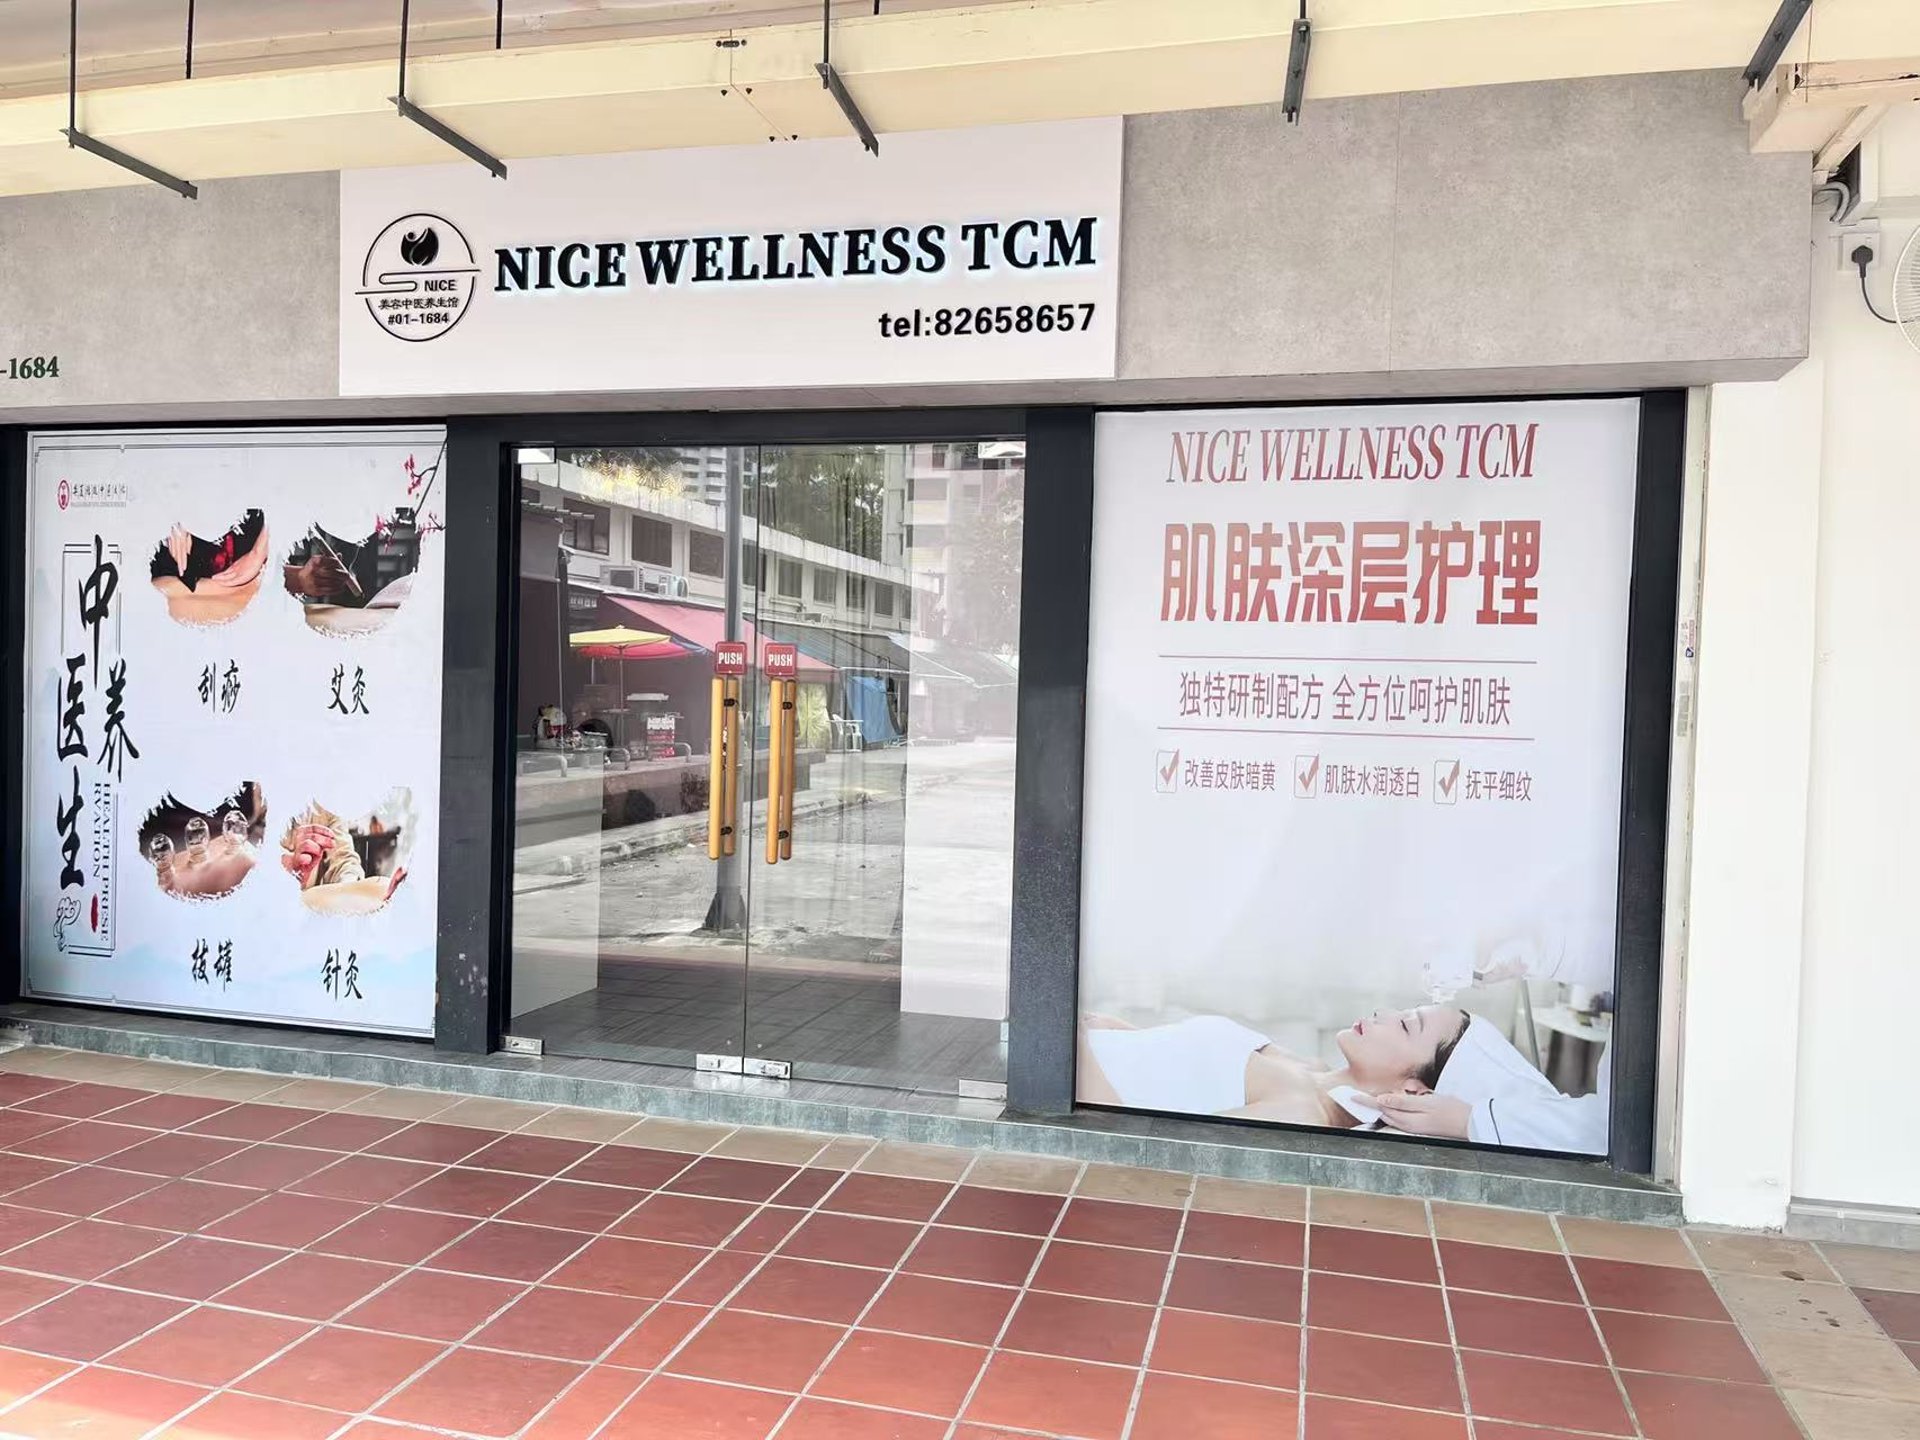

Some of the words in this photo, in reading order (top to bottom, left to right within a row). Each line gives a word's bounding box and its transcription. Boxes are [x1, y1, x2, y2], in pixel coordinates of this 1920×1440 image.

[494, 242, 627, 292] NICE
[635, 224, 946, 286] WELLNESS
[960, 217, 1098, 270] TCM
[378, 296, 459, 310] 美容中医养生馆
[424, 279, 457, 292] NICE
[387, 312, 449, 326] #01-1684
[878, 303, 1096, 338] tel:82658657
[1166, 430, 1251, 483] NICE
[1260, 424, 1446, 481] WELLNESS
[1455, 422, 1540, 479] TCM
[1160, 520, 1542, 624] 肌肤深层护理
[718, 652, 743, 665] PUSH
[768, 654, 793, 667] PUSH
[57, 534, 140, 891] 中医养生
[197, 658, 241, 714] 刮痧
[327, 662, 370, 715] 艾灸
[1179, 670, 1325, 721] 独特研制配方
[1331, 672, 1512, 726] 全方位呵护肌肤
[1183, 758, 1276, 792] 改善皮肤暗黄
[1323, 764, 1420, 798] 肌肤水润透白
[1464, 770, 1533, 802] 抚平细纹
[93, 783, 102, 878] RVATION
[102, 783, 111, 870] HEALTH
[100, 877, 110, 942] PRESE
[320, 947, 363, 1002] 针灸
